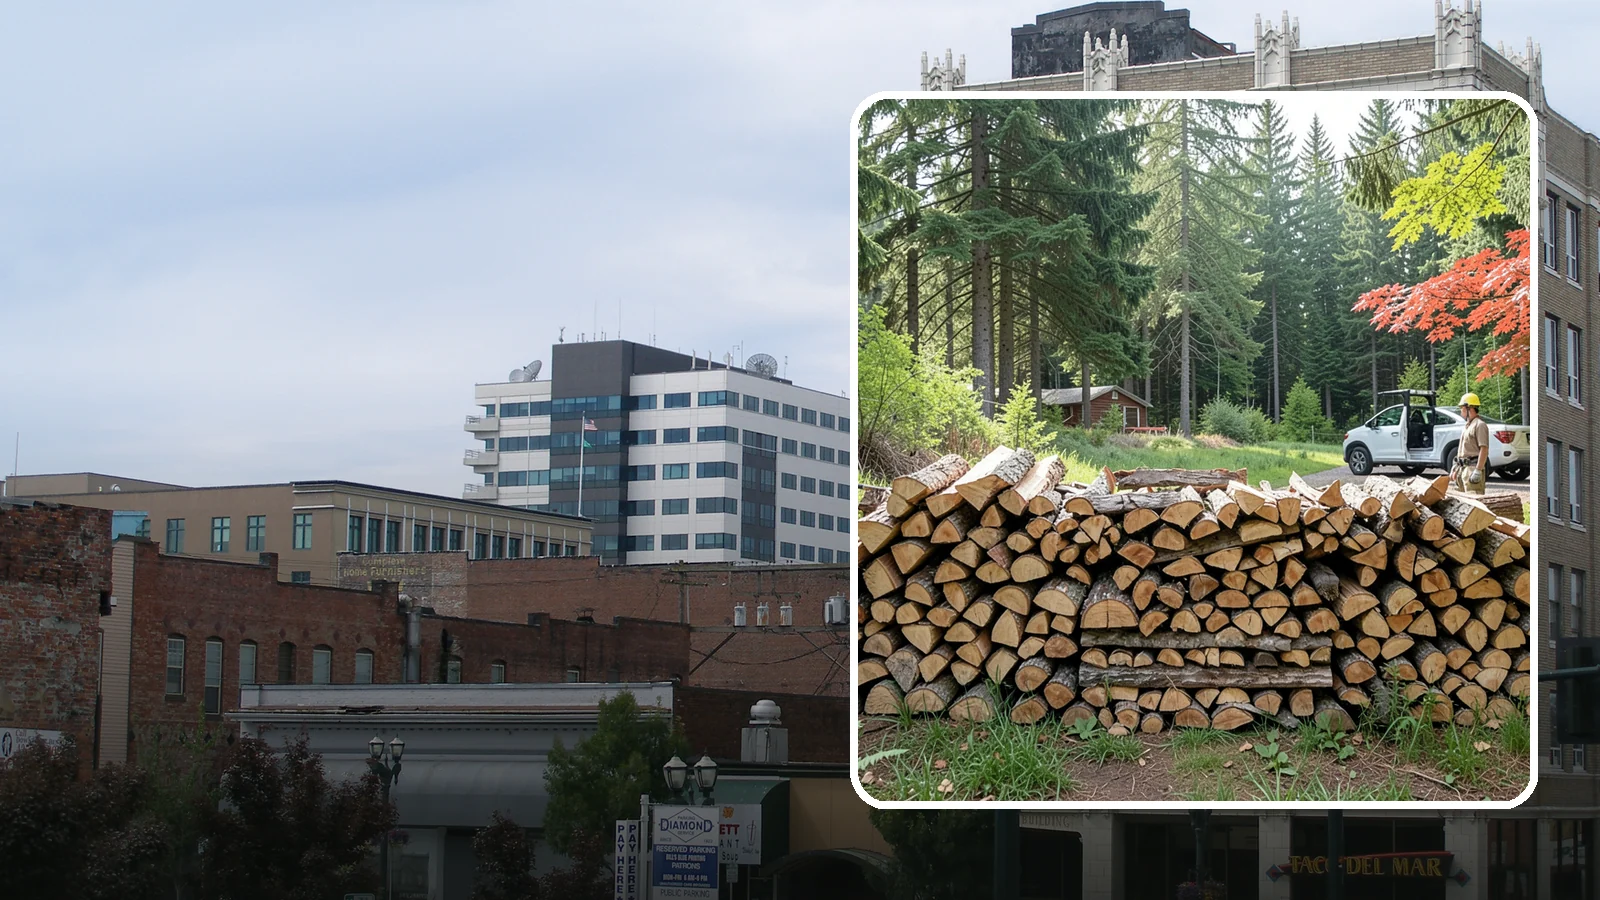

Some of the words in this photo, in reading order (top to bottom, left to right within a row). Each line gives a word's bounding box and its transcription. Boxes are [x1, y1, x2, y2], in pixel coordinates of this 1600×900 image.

[370, 566, 427, 577] Furnishers
[660, 818, 713, 833] DIAMOND
[1022, 815, 1070, 827] BUILDING
[617, 824, 625, 852] PAY
[628, 824, 637, 852] PAY
[655, 845, 688, 853] RESERVED
[689, 846, 716, 854] PARKING
[721, 851, 739, 861] Soup
[671, 861, 701, 870] PATRONS
[1345, 857, 1385, 876] DEL
[1392, 857, 1442, 877] MAR
[616, 855, 625, 893] HERE
[627, 855, 636, 893] HERE
[660, 888, 682, 897] PUBLIC
[683, 889, 710, 898] PARKING
